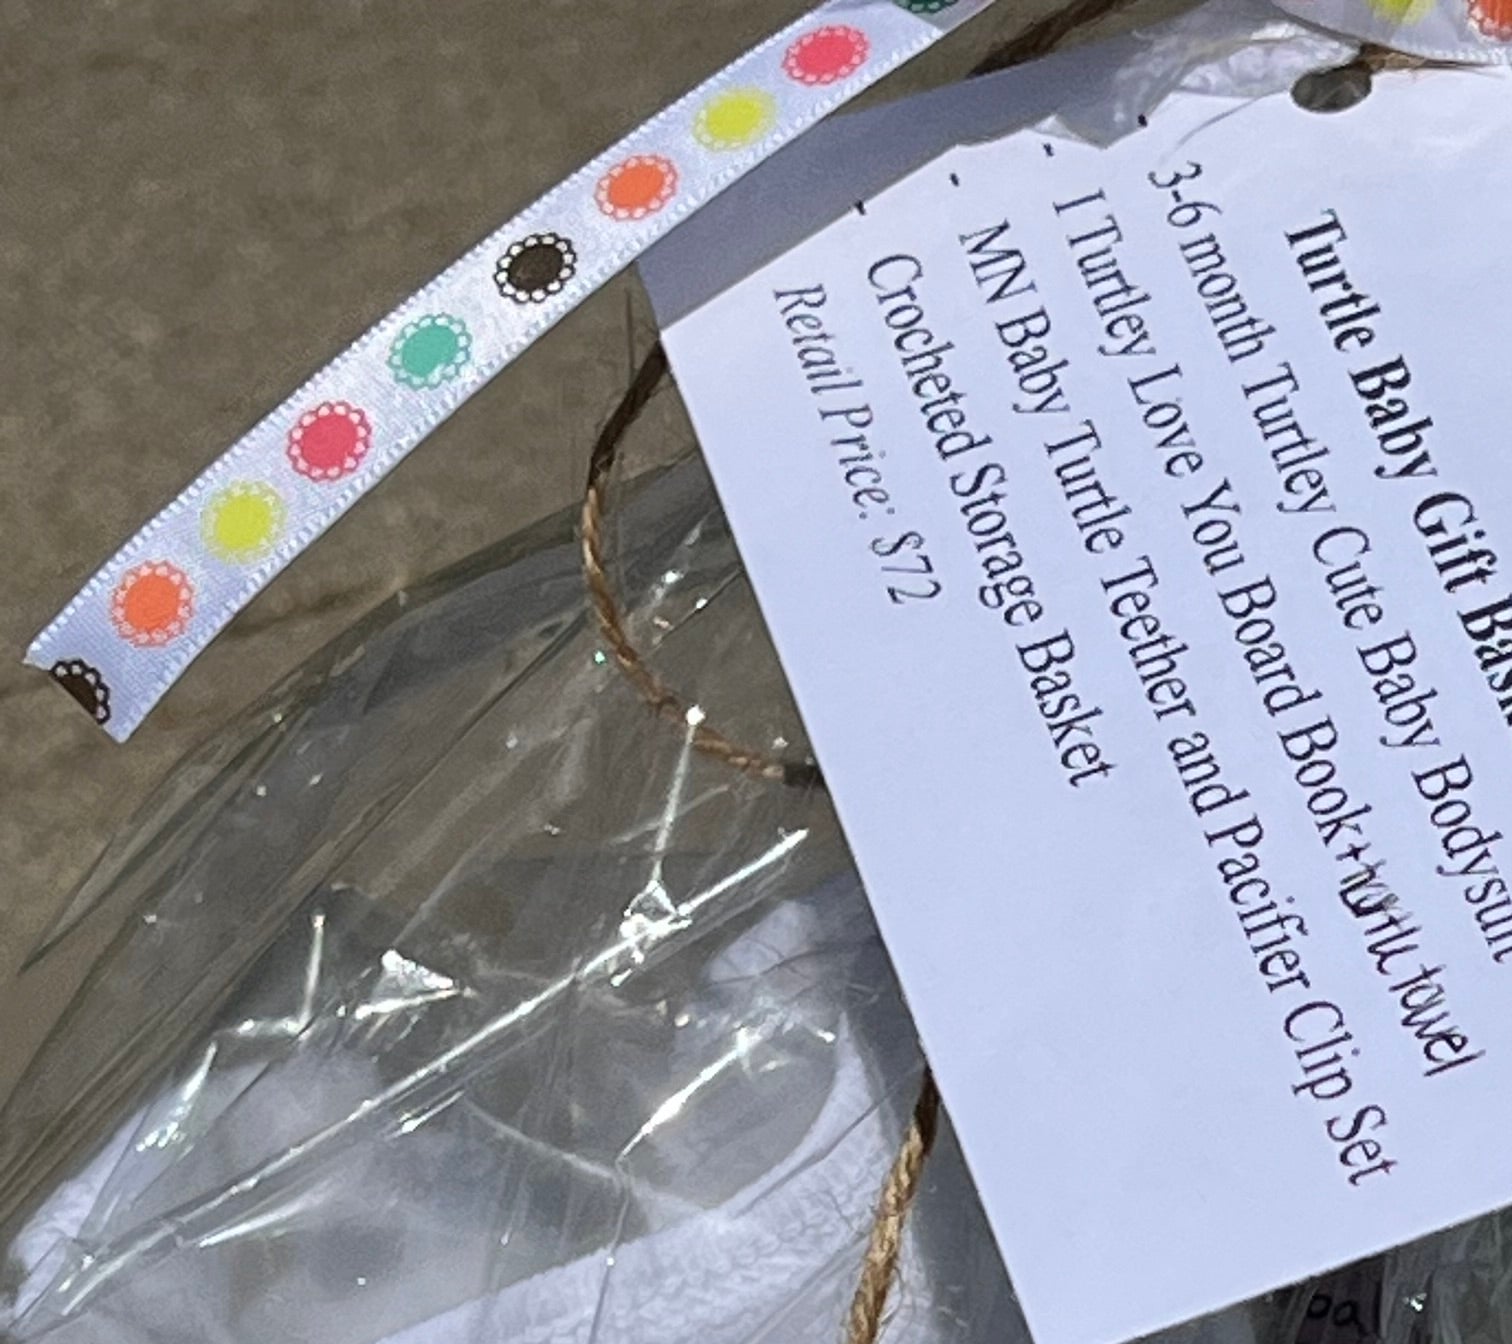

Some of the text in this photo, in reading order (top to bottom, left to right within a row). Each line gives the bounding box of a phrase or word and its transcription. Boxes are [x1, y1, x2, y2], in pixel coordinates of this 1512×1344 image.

[1147, 161, 1222, 228] 3-6
[1178, 231, 1277, 364] month
[773, 283, 942, 604] Retail Price: $72
[1051, 188, 1373, 847] I Turtley Love You Board Book
[1240, 360, 1337, 513] Turtley
[1283, 207, 1382, 352] Turtle
[1347, 353, 1438, 480] Baby
[1412, 490, 1498, 594] Gift
[866, 253, 1116, 788] Crocheted Storage Basket
[1311, 525, 1384, 630] Cute
[958, 218, 1397, 1187] MN Baby Turtle Teether and Pacifier Clip Set
[1355, 629, 1441, 748] Baby
